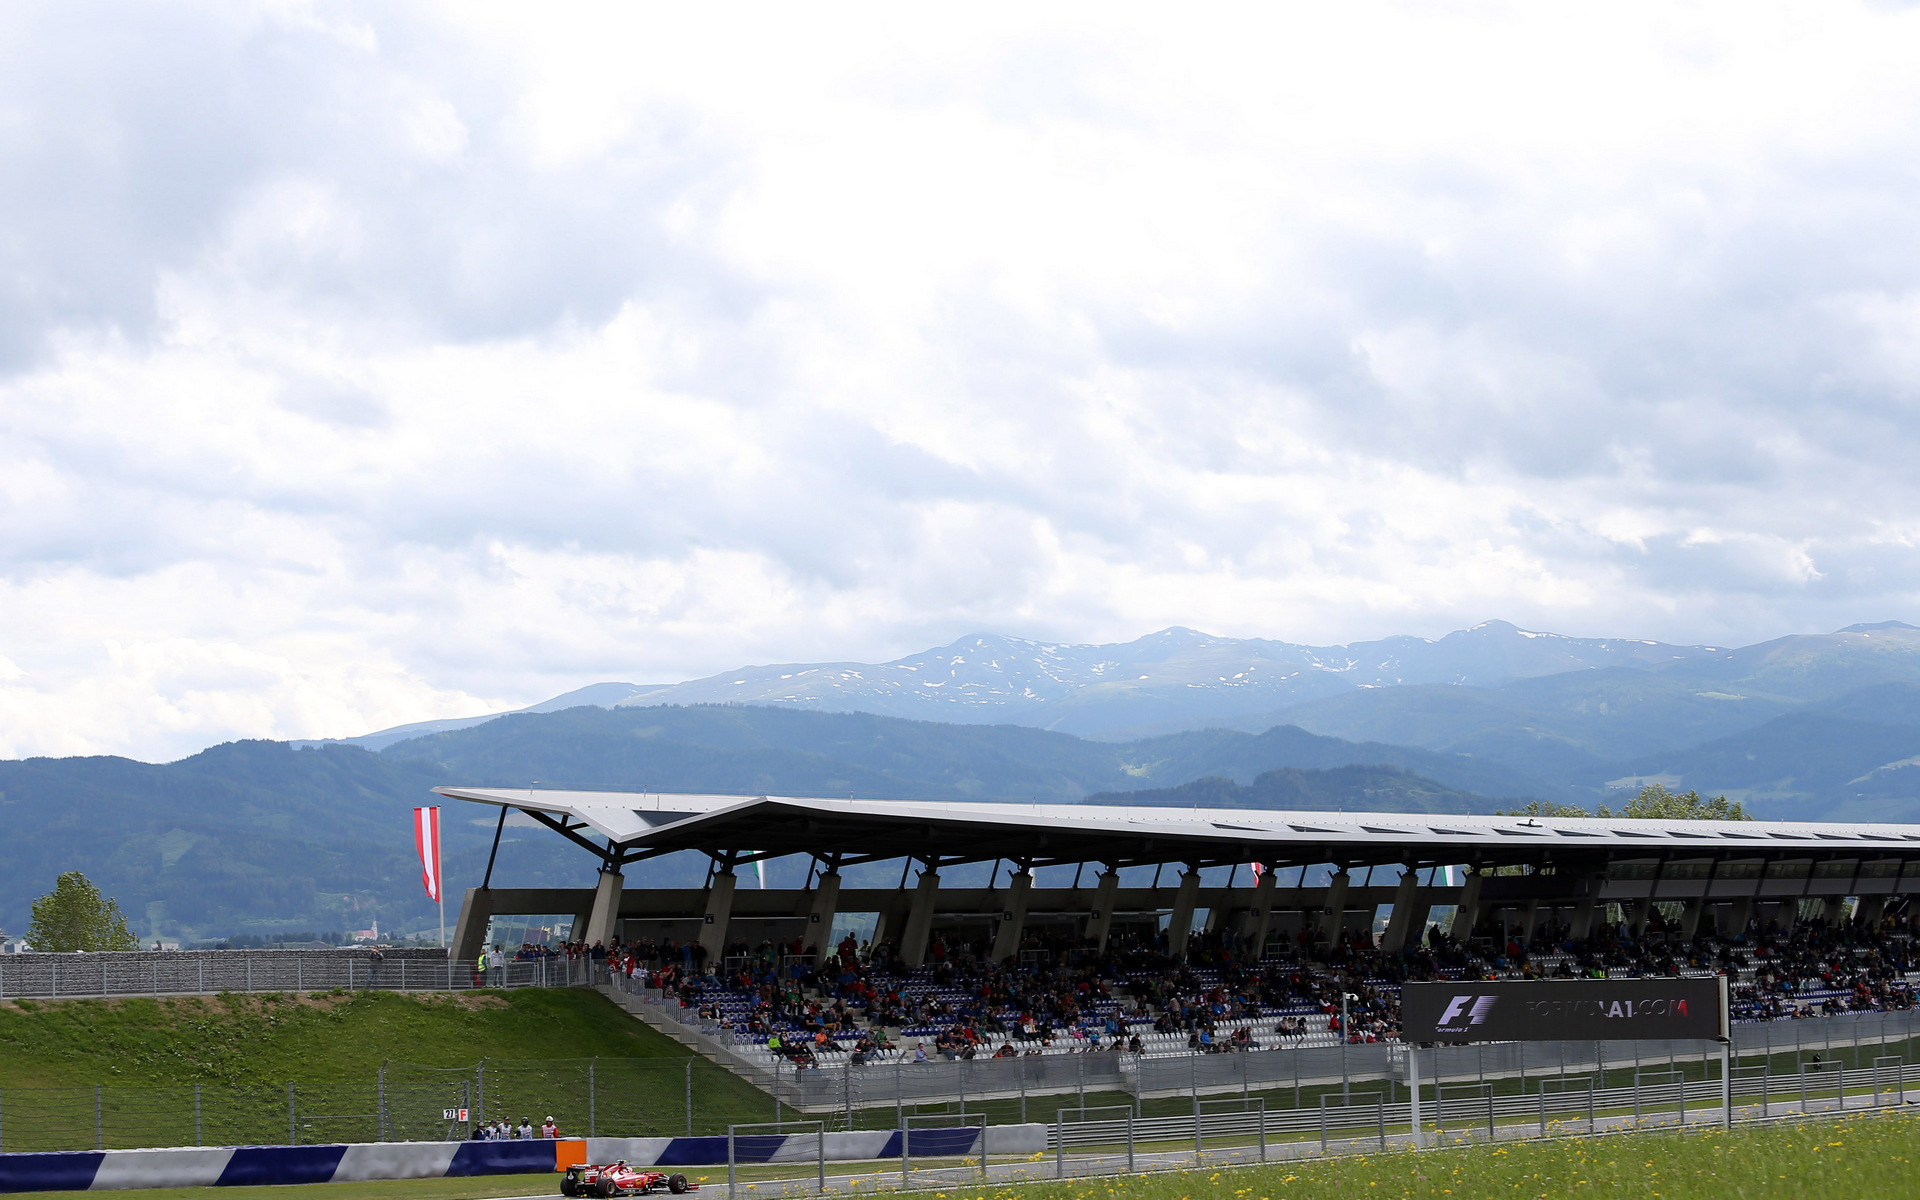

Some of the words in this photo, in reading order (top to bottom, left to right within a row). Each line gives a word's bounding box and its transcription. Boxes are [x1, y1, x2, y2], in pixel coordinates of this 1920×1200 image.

[1437, 995, 1500, 1025] F1
[445, 1109, 454, 1118] 27
[460, 1110, 466, 1120] F
